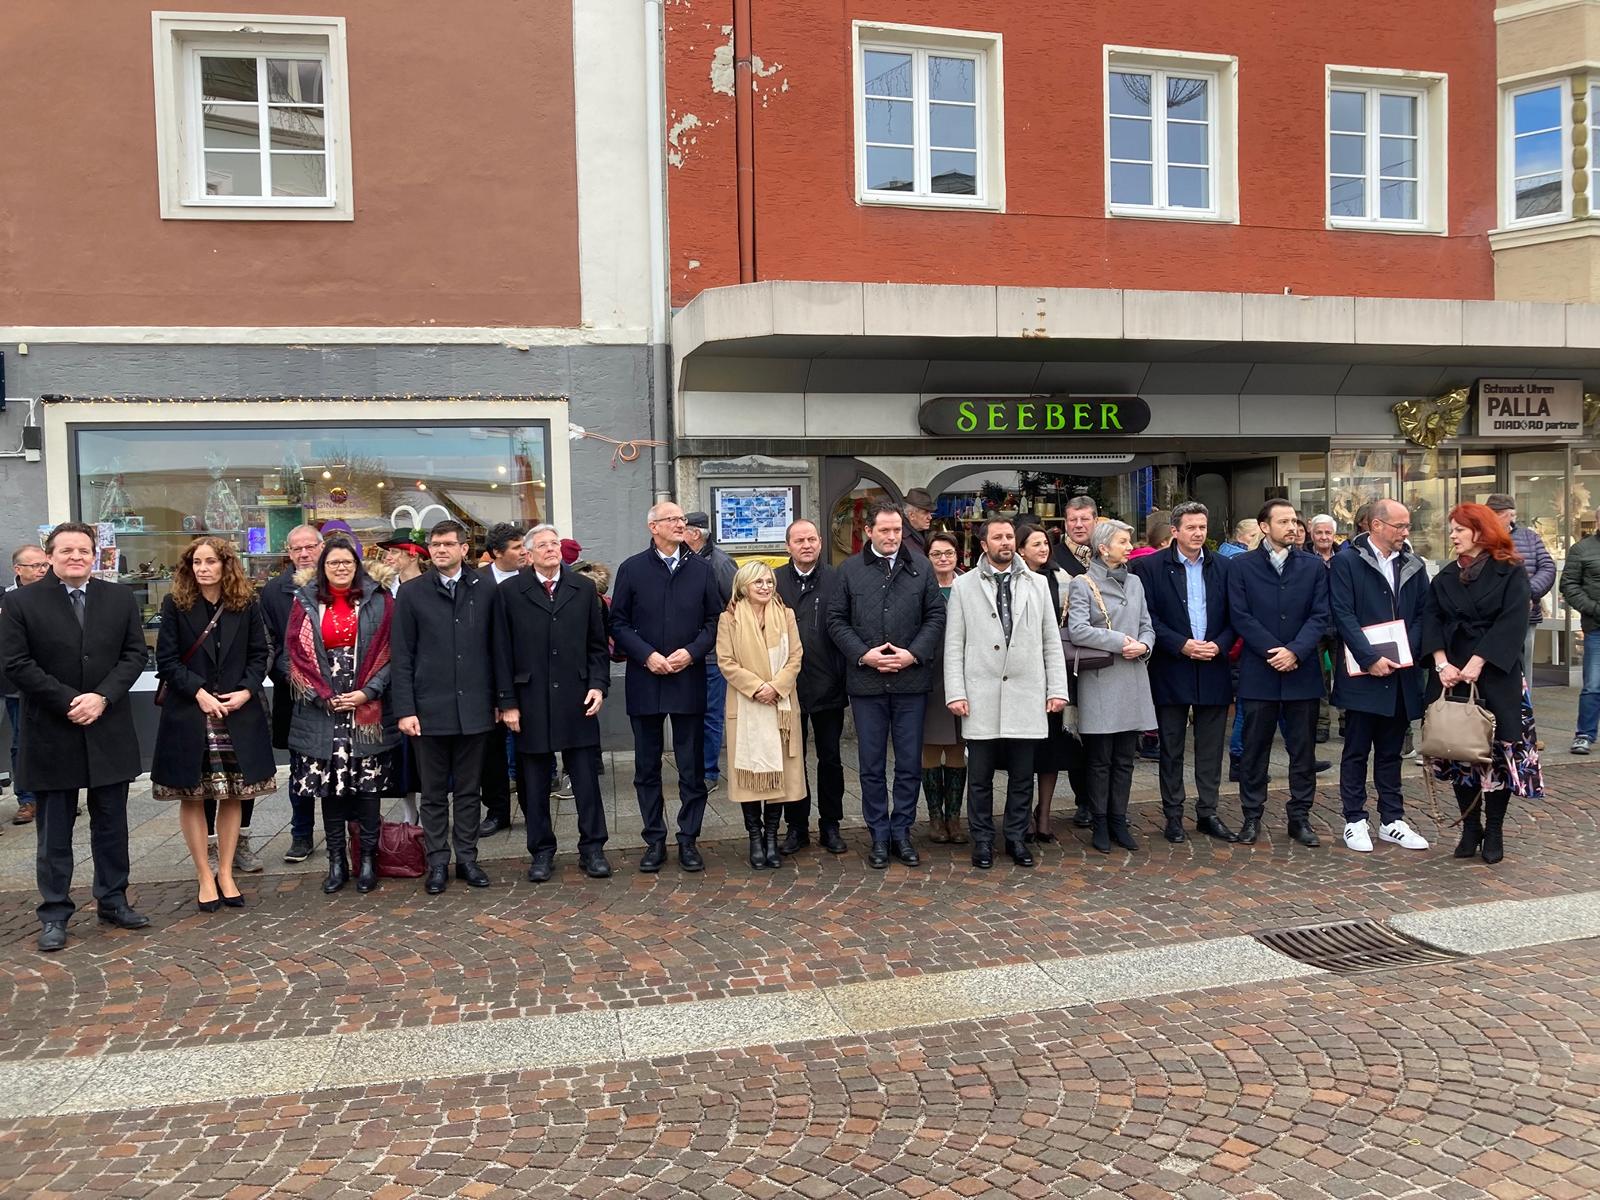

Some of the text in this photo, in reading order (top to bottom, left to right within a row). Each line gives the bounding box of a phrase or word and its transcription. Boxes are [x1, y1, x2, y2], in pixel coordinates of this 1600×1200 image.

[1483, 383, 1555, 394] Schmuck Uhren
[1487, 397, 1551, 417] PALLA
[956, 401, 1124, 432] SEEBER
[1545, 421, 1580, 431] partner
